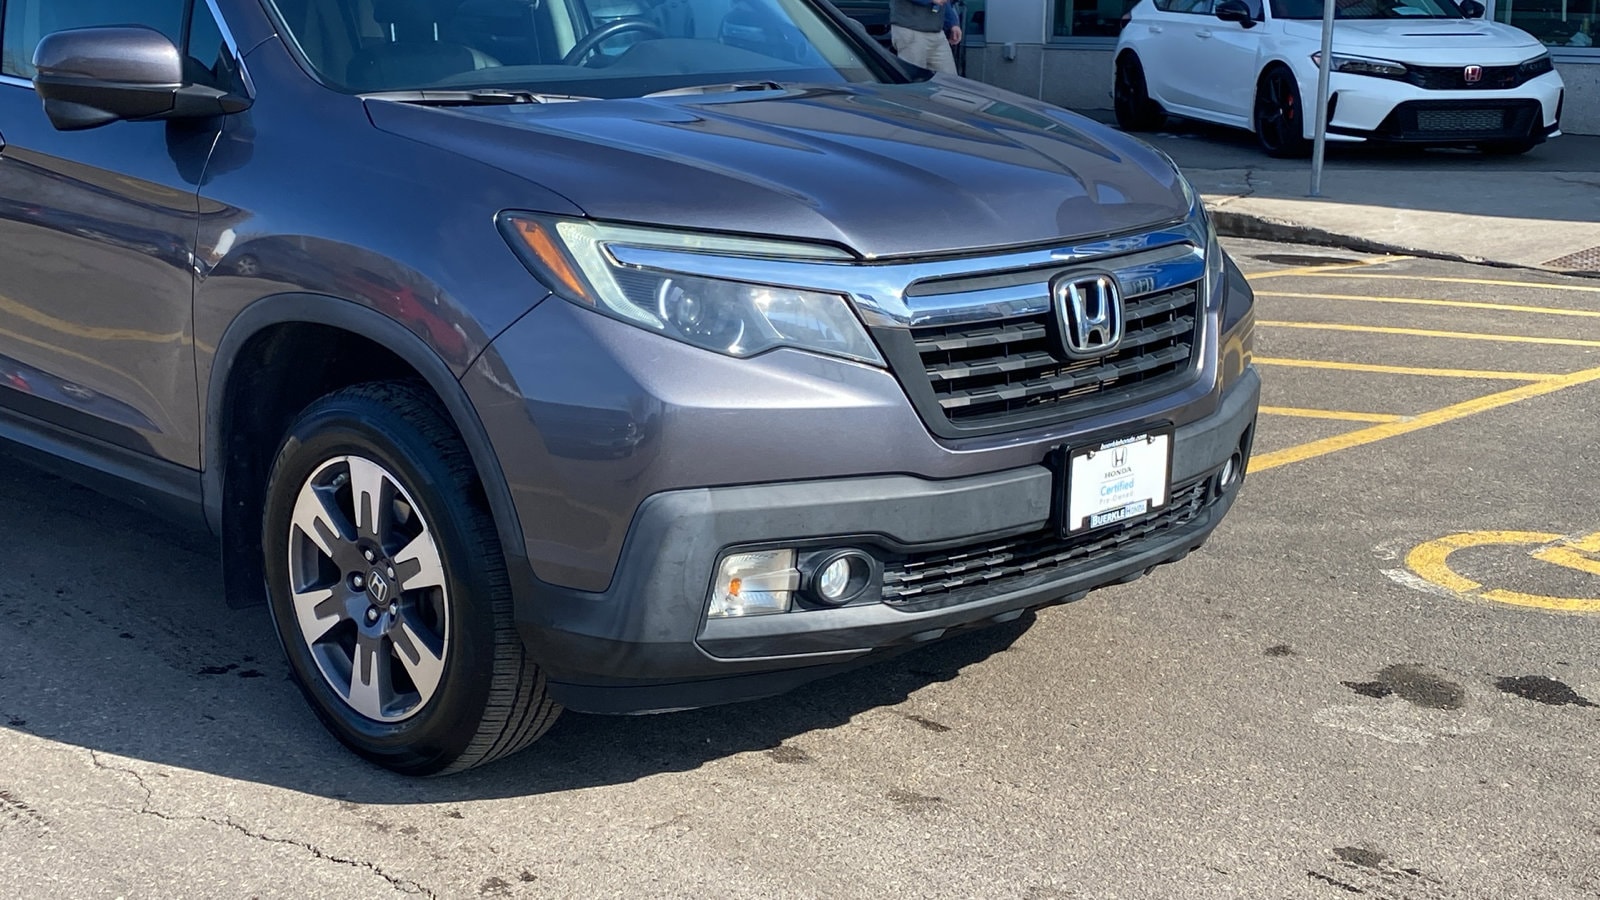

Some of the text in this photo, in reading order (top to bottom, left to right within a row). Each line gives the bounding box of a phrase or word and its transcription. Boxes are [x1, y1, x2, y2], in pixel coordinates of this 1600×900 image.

[1104, 466, 1132, 479] HONDA
[1100, 478, 1135, 497] Certified
[1092, 509, 1125, 526] BUERKLE
